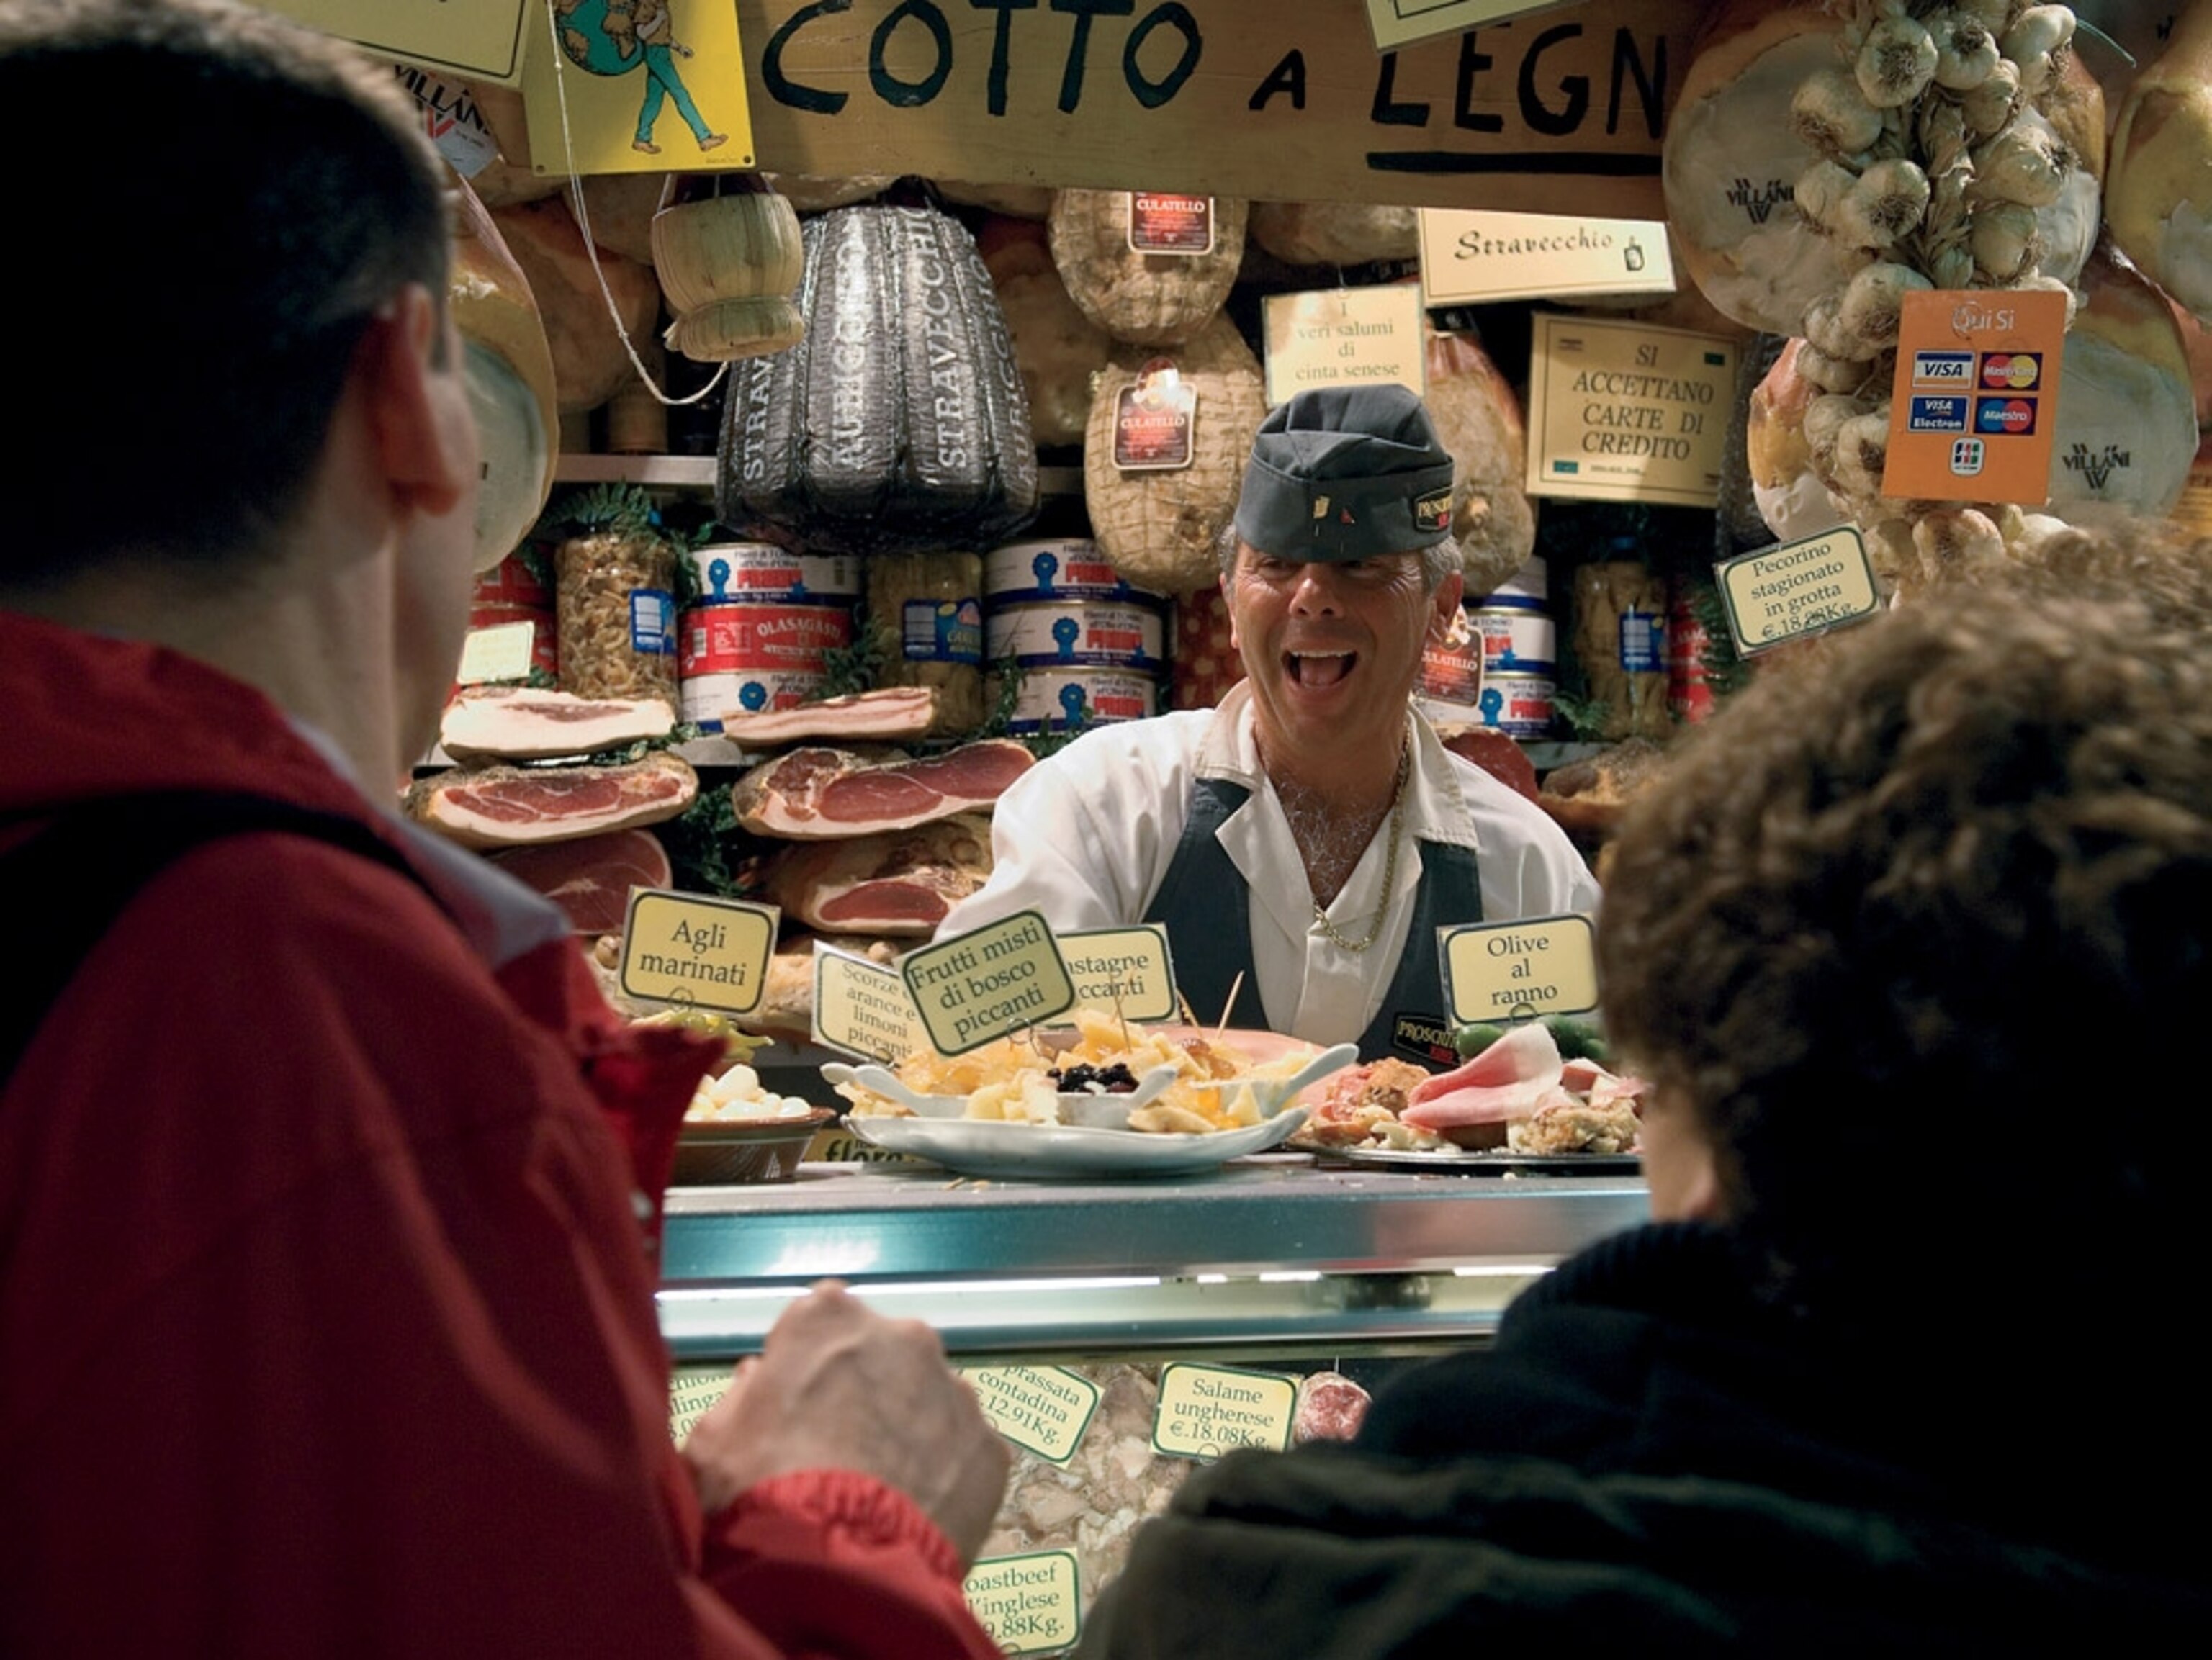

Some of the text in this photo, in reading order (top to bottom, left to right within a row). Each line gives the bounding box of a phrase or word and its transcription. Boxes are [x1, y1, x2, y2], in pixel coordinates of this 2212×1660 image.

[761, 0, 1668, 139] COTTO A LEGN
[395, 64, 490, 136] VILLAN
[1136, 198, 1205, 213] CULATELLO
[1454, 226, 1614, 261] Stravecchio
[1298, 318, 1394, 340] veri salumi
[1995, 310, 2015, 331] Si
[1337, 341, 1355, 358] di
[1635, 343, 1659, 368] SI
[1295, 361, 1401, 381] cinta senese
[1924, 363, 1963, 376] VISA
[1572, 370, 1716, 405] ACCETTANO
[744, 358, 775, 481] STRAV
[1583, 402, 1704, 436] CARTE DI
[1925, 400, 1954, 410] VISA
[1983, 410, 2028, 421] Maestro
[1120, 415, 1185, 430] CULATELLO
[1913, 416, 1963, 428] Electron
[1581, 430, 1691, 461] CREDITO
[1752, 543, 1832, 578] Pecorino
[1750, 561, 1845, 600] stagionato
[1764, 583, 1842, 618] in grotta
[670, 919, 727, 955] Agli
[1487, 935, 1550, 957] Olive
[639, 953, 747, 986] marinati
[908, 920, 1042, 991] Frutti misti
[1067, 955, 1149, 978] stagne
[1511, 958, 1532, 979] al
[842, 962, 899, 996] Scorze
[939, 960, 1036, 1009] di bosco
[1079, 975, 1145, 999] ccanti
[846, 987, 902, 1016] arance
[905, 1009, 916, 1021] e
[1491, 985, 1558, 1006] ranno
[853, 1004, 907, 1039] limoni
[953, 982, 1046, 1044] piccanti
[978, 1371, 1068, 1423] contadina
[1003, 1366, 1081, 1407] prassata
[1192, 1378, 1264, 1404] Salame
[1174, 1402, 1274, 1427] ungherese
[965, 1561, 1058, 1593] oastbeef
[968, 1591, 1060, 1619] l'inglese
[982, 1613, 1065, 1639] 9.88Kg.
